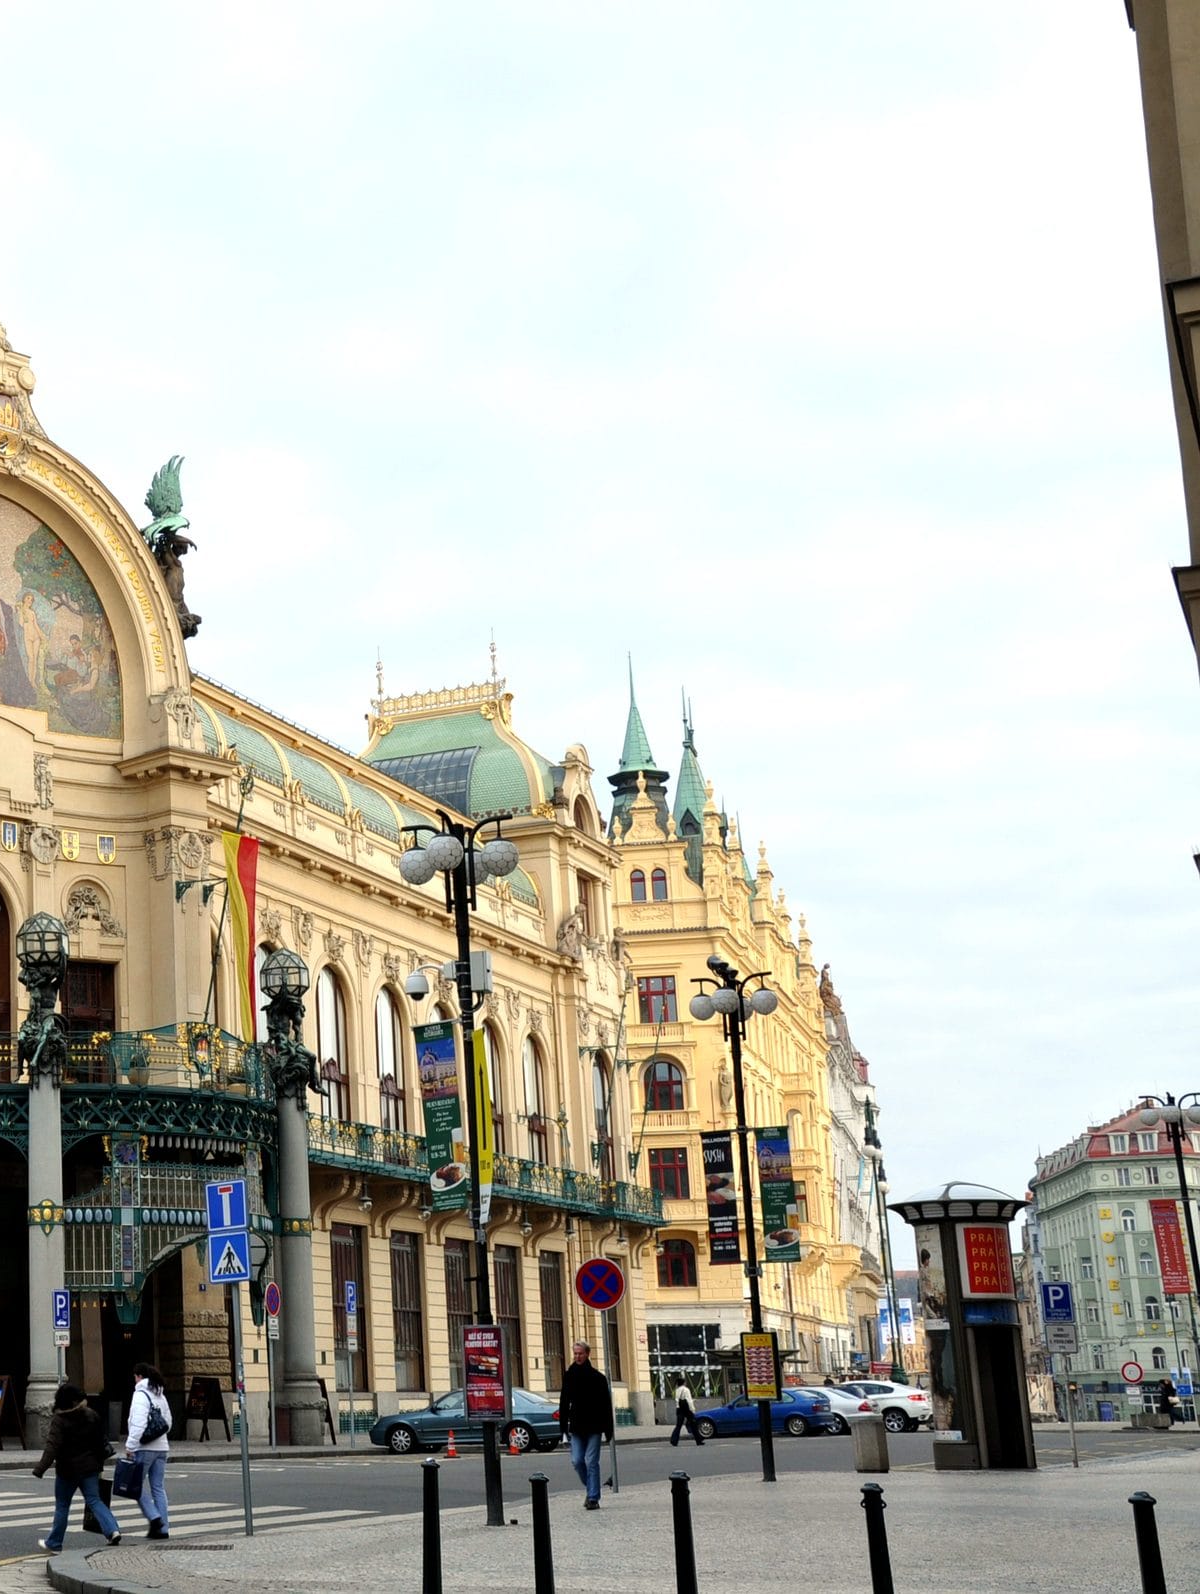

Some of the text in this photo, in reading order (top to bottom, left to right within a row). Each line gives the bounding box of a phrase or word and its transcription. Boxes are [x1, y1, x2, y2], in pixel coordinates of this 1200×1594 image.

[56, 1294, 66, 1317] P
[348, 1286, 354, 1304] P
[1048, 1286, 1064, 1309] P
